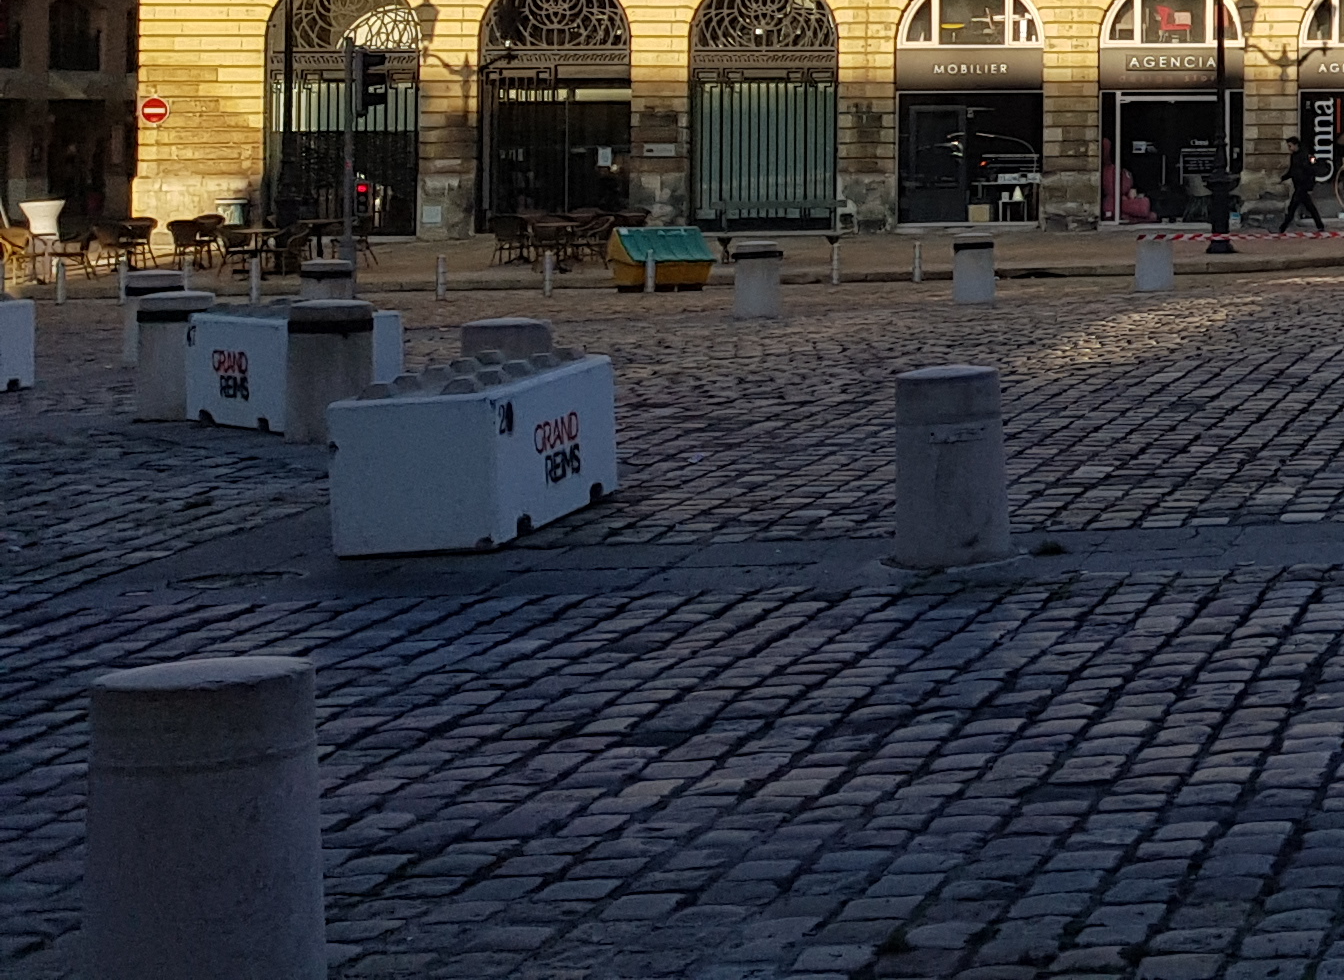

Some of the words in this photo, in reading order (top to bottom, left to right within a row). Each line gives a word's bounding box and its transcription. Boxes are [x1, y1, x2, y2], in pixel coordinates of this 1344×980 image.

[1129, 56, 1217, 68] AGENCIA
[933, 63, 1009, 74] MOBILIER
[534, 411, 579, 454] GRAND
